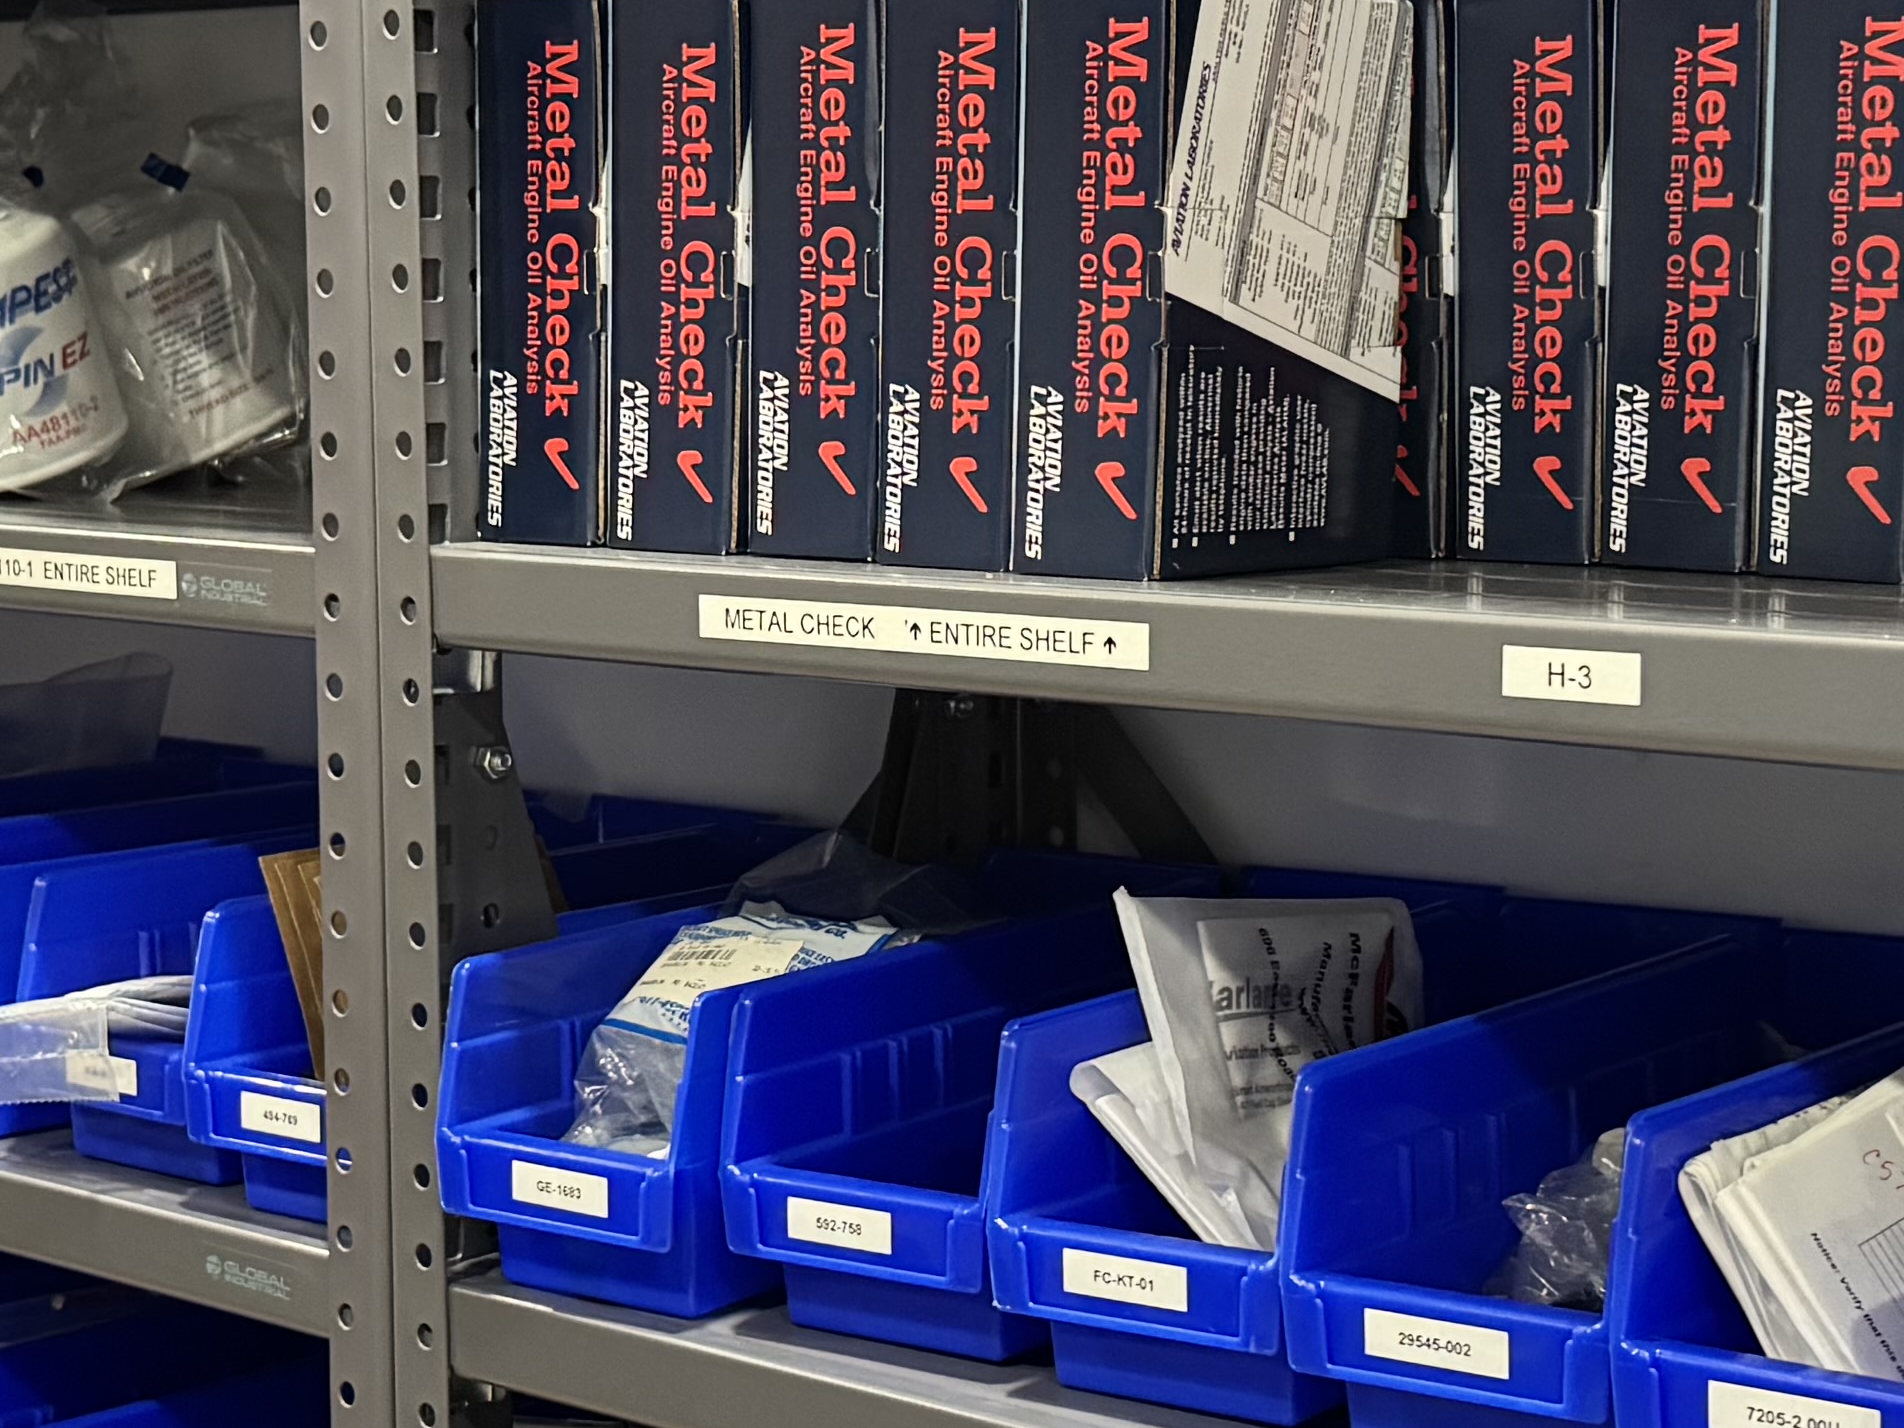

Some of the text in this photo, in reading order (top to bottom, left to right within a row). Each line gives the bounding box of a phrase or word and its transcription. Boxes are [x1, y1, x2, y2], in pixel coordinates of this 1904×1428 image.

[798, 47, 818, 396] Aircraft Engine Oil Analysis
[820, 24, 857, 419] Metal Check
[773, 371, 789, 471] AVIATION
[757, 370, 774, 536] LABORATORIES
[44, 560, 100, 585] ENTIRE
[105, 565, 157, 589] SHELF
[199, 575, 267, 598] GLOBAL
[725, 608, 875, 640] METAL CHECK
[930, 622, 1095, 655] ENTIRE SHELF
[1547, 662, 1593, 689] H-3
[1093, 1269, 1154, 1292] FC-KT-01
[1398, 1332, 1472, 1357] 29545-002
